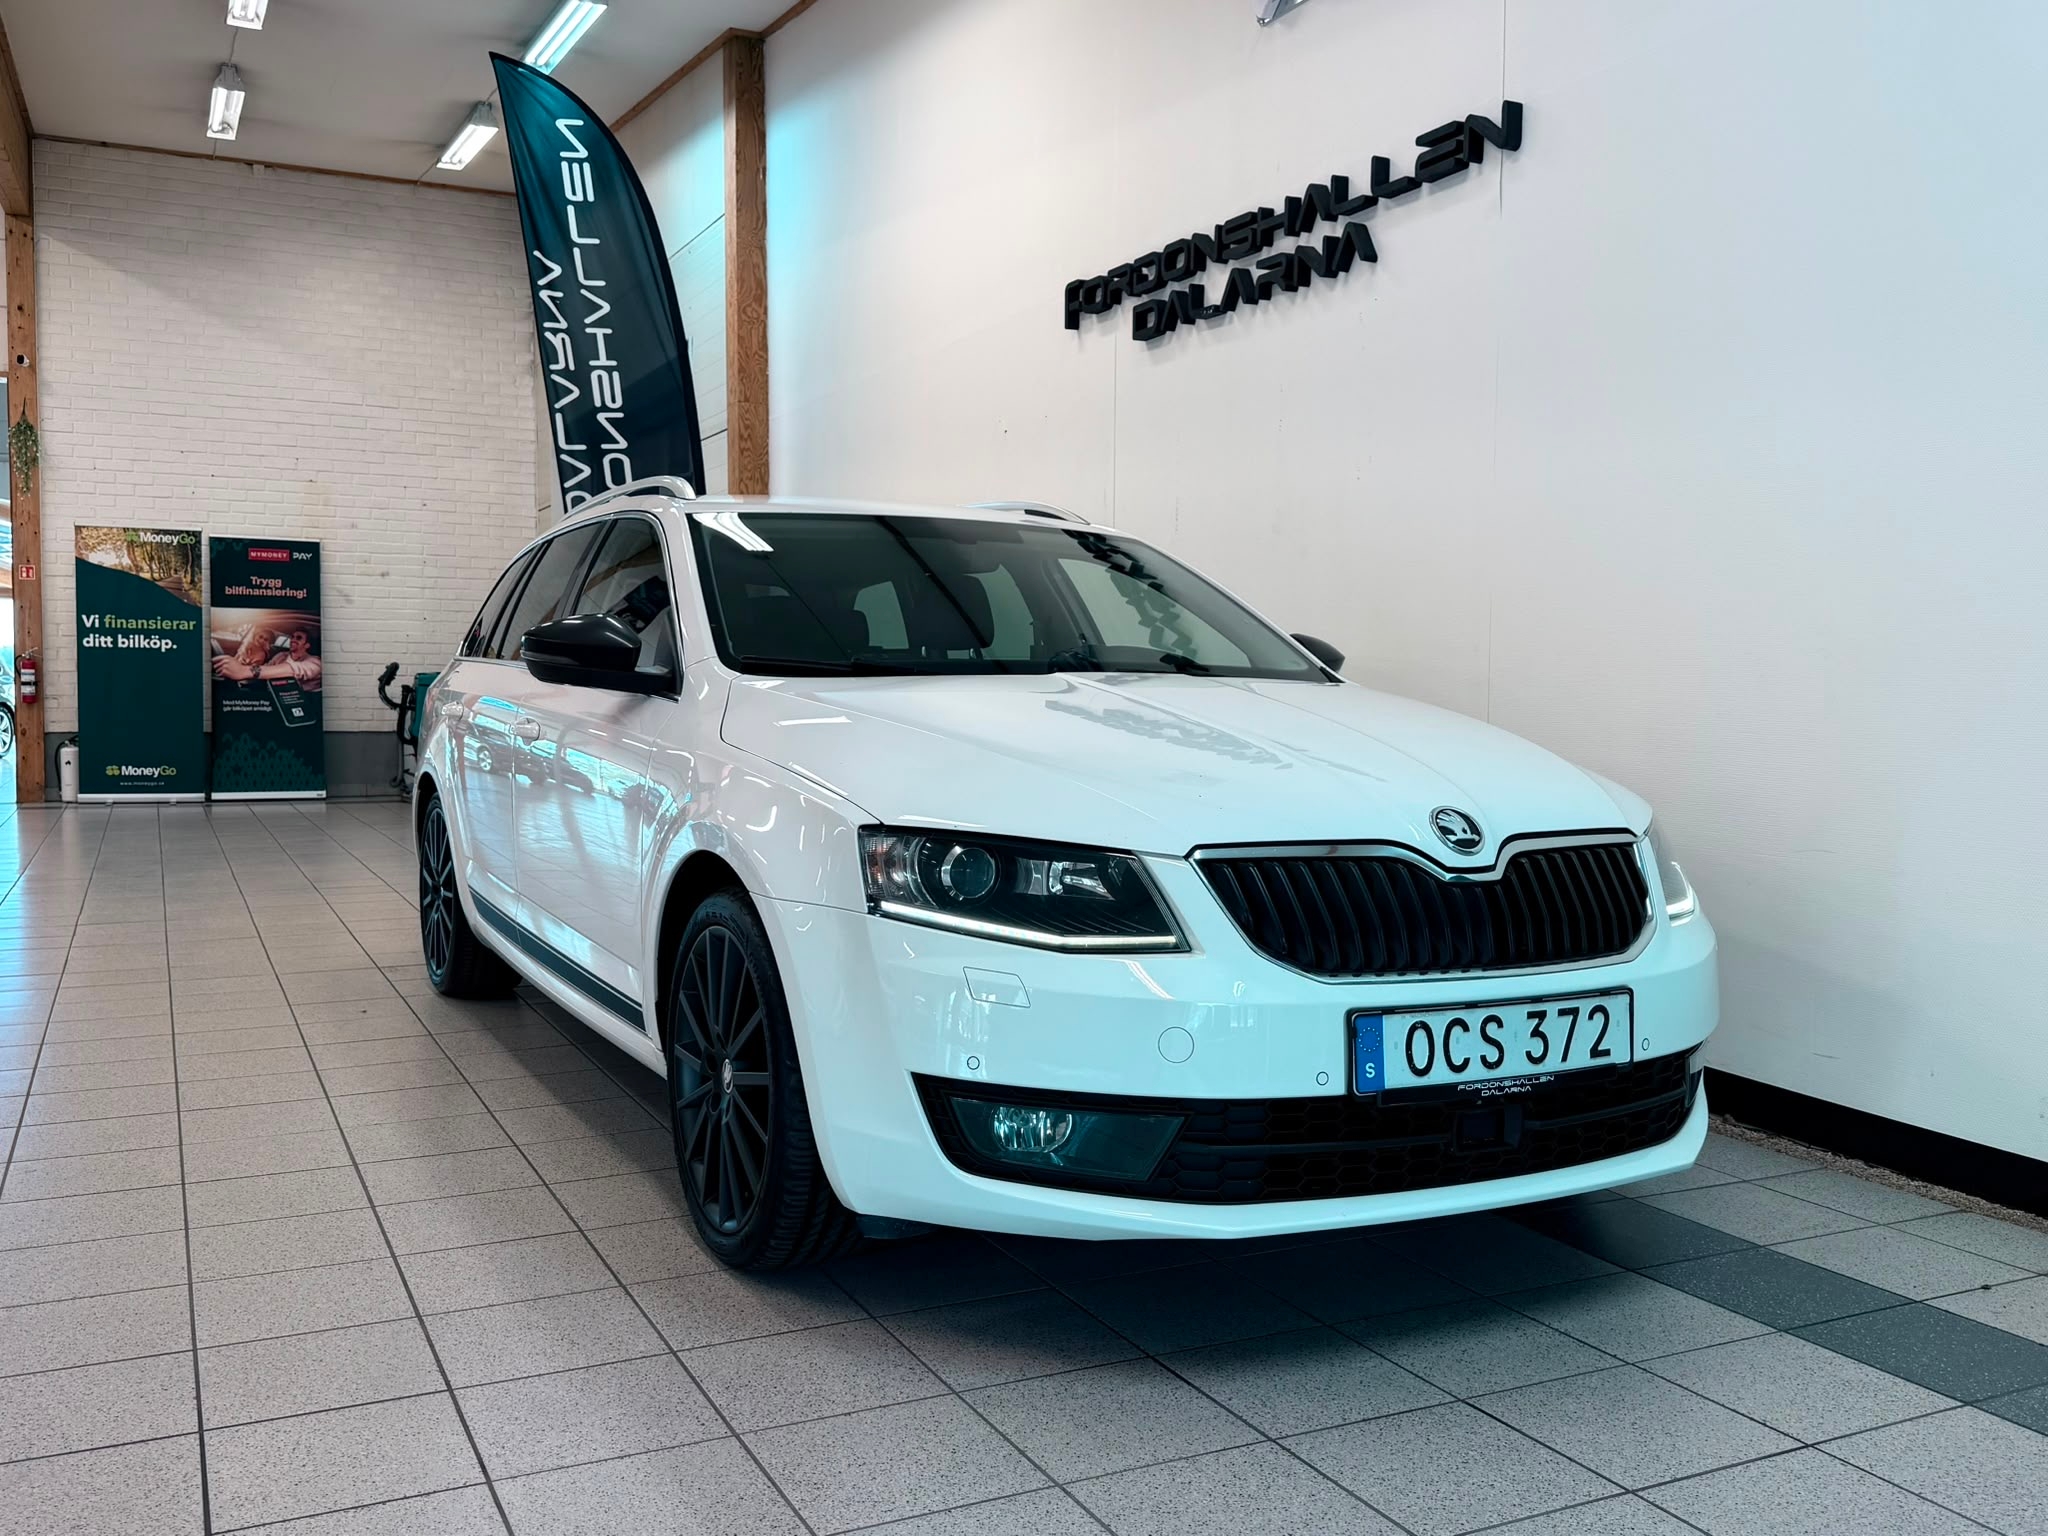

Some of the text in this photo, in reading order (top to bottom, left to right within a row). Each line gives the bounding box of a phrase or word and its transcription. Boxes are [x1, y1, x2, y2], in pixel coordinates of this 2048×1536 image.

[1065, 100, 1523, 330] FORDONSHALLEN
[1132, 221, 1378, 341] DALARNA
[140, 532, 196, 545] MoneyGo
[250, 551, 313, 560] MYMONEY PAY
[250, 576, 282, 587] Trygg
[225, 586, 307, 599] bilfinansiering!
[82, 614, 196, 630] Vi finansierar
[82, 633, 177, 652] ditt bilköp.
[121, 765, 177, 778] MoneyGo
[1405, 1004, 1611, 1077] OCS 372
[1365, 1063, 1376, 1078] S
[1457, 1075, 1555, 1091] FORDONSHALLEN
[1481, 1085, 1532, 1097] DALARNA
